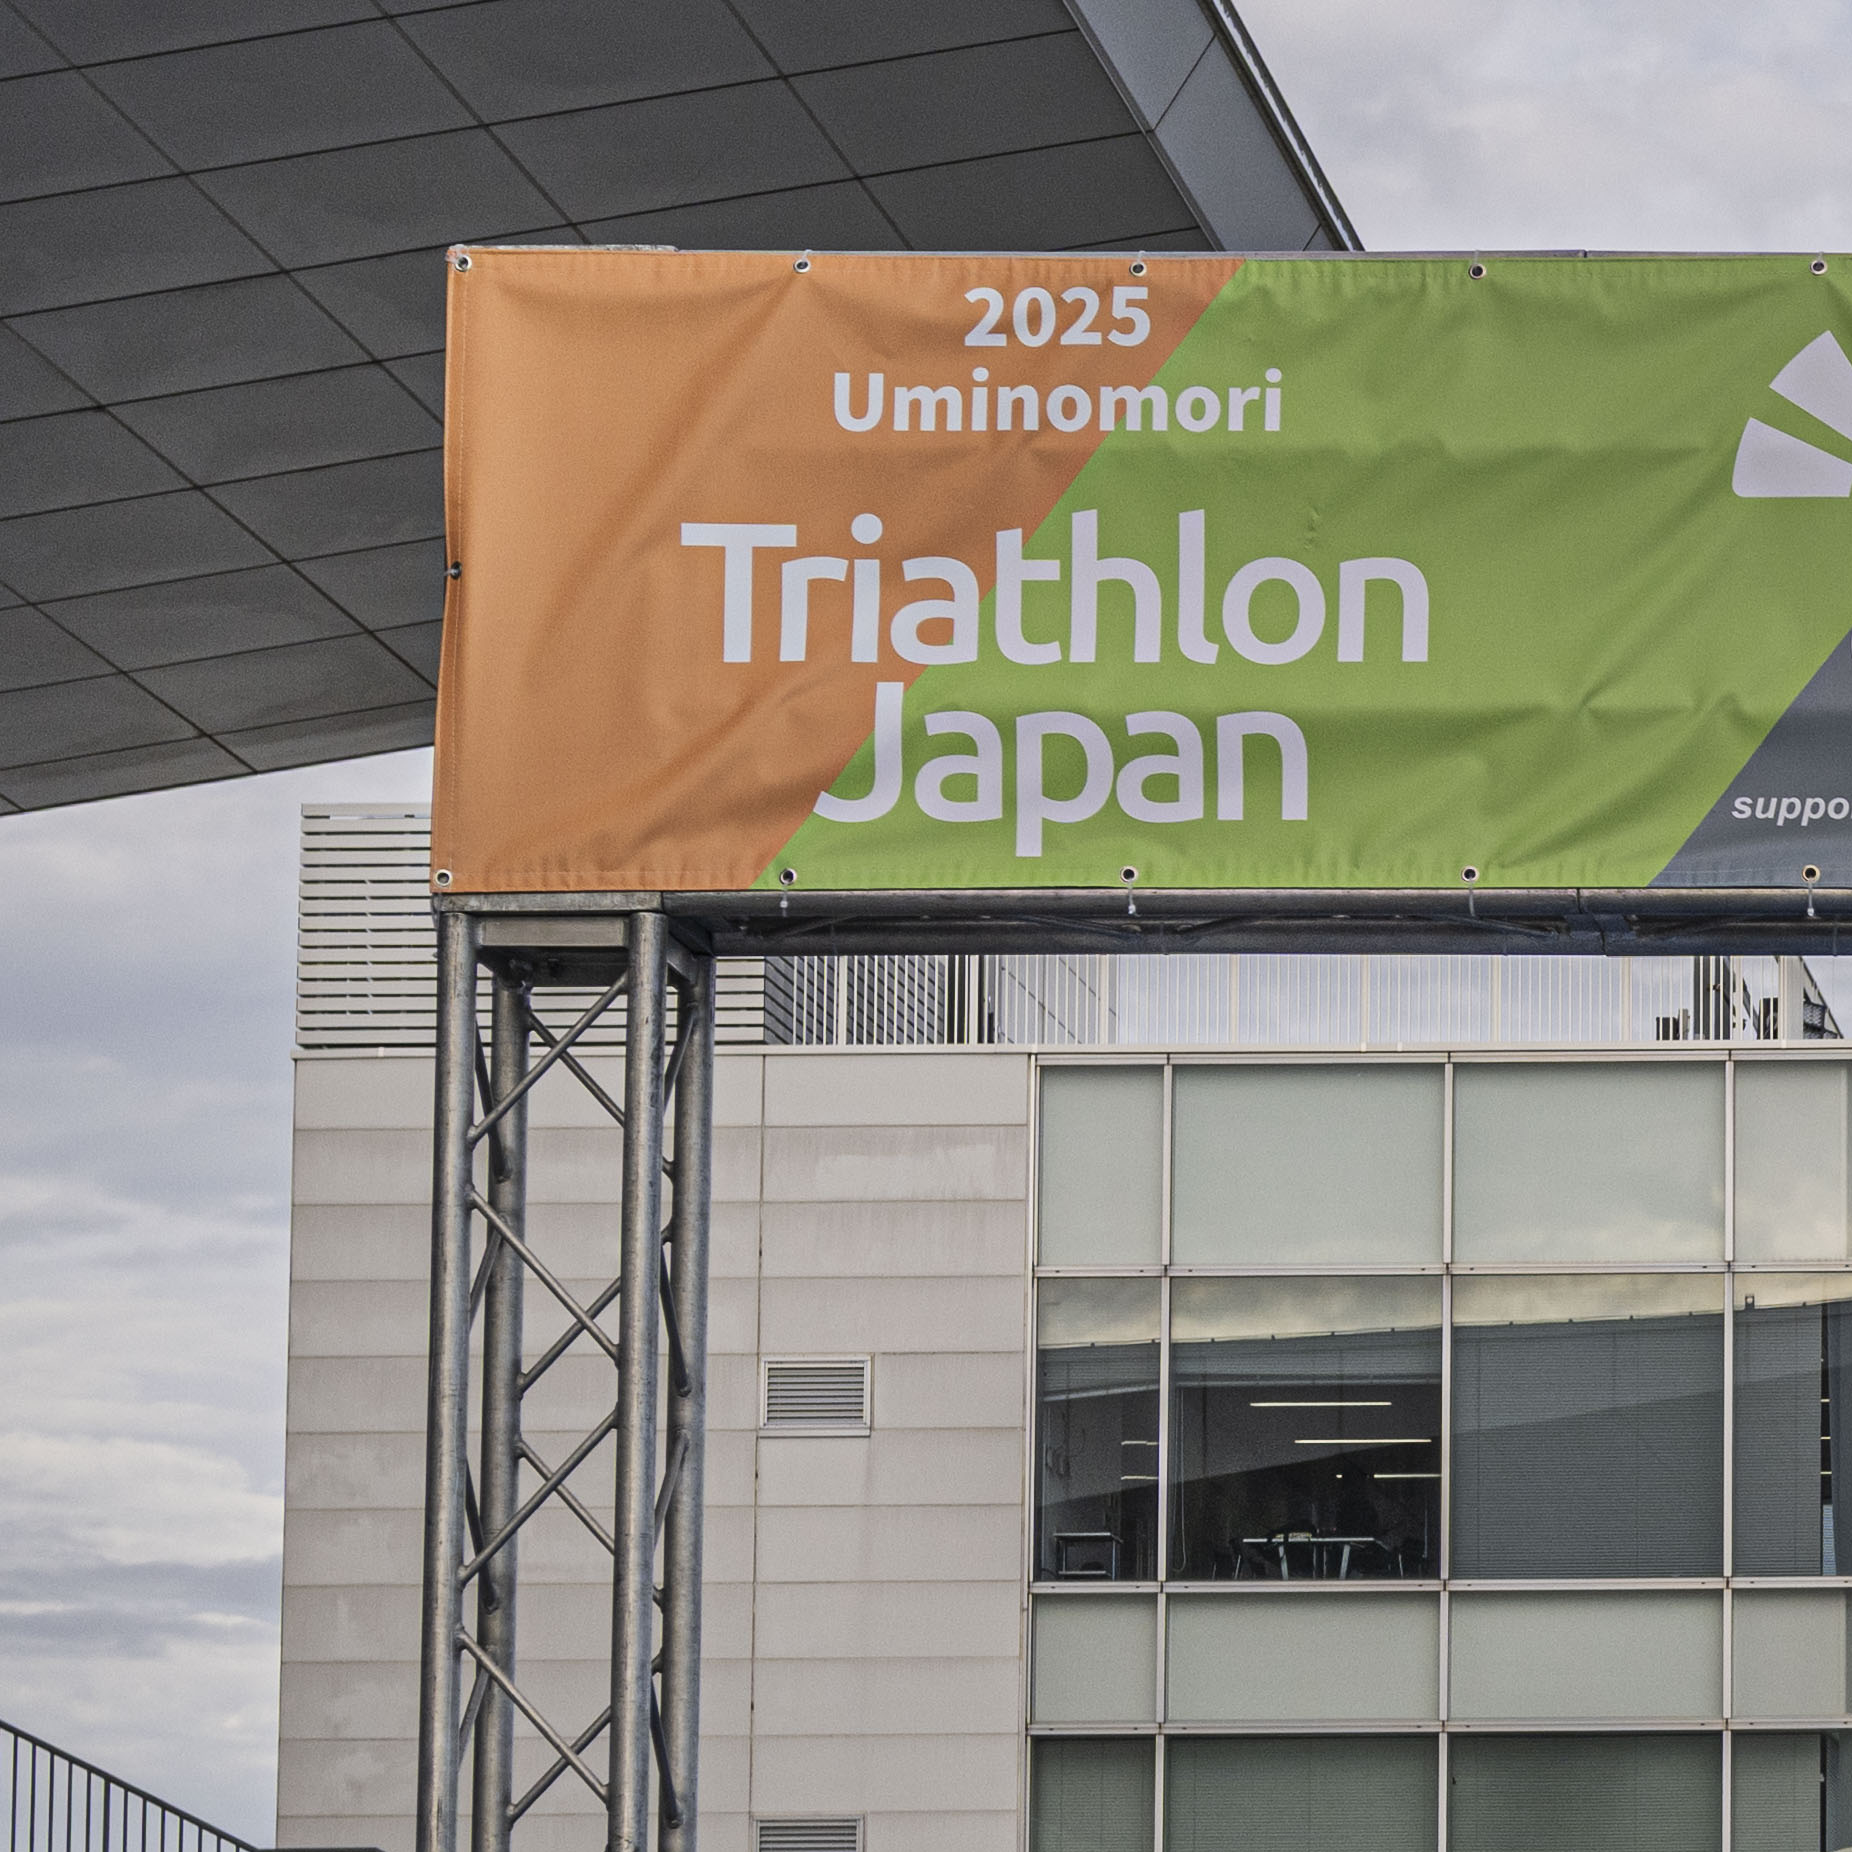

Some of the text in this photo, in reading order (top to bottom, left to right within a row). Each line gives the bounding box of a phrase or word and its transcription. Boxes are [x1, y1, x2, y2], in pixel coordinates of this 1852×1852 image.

[963, 286, 1152, 348] 2025
[831, 369, 1283, 432] Uminomori
[679, 509, 1431, 665] Triathlon
[814, 681, 1310, 859] Japan
